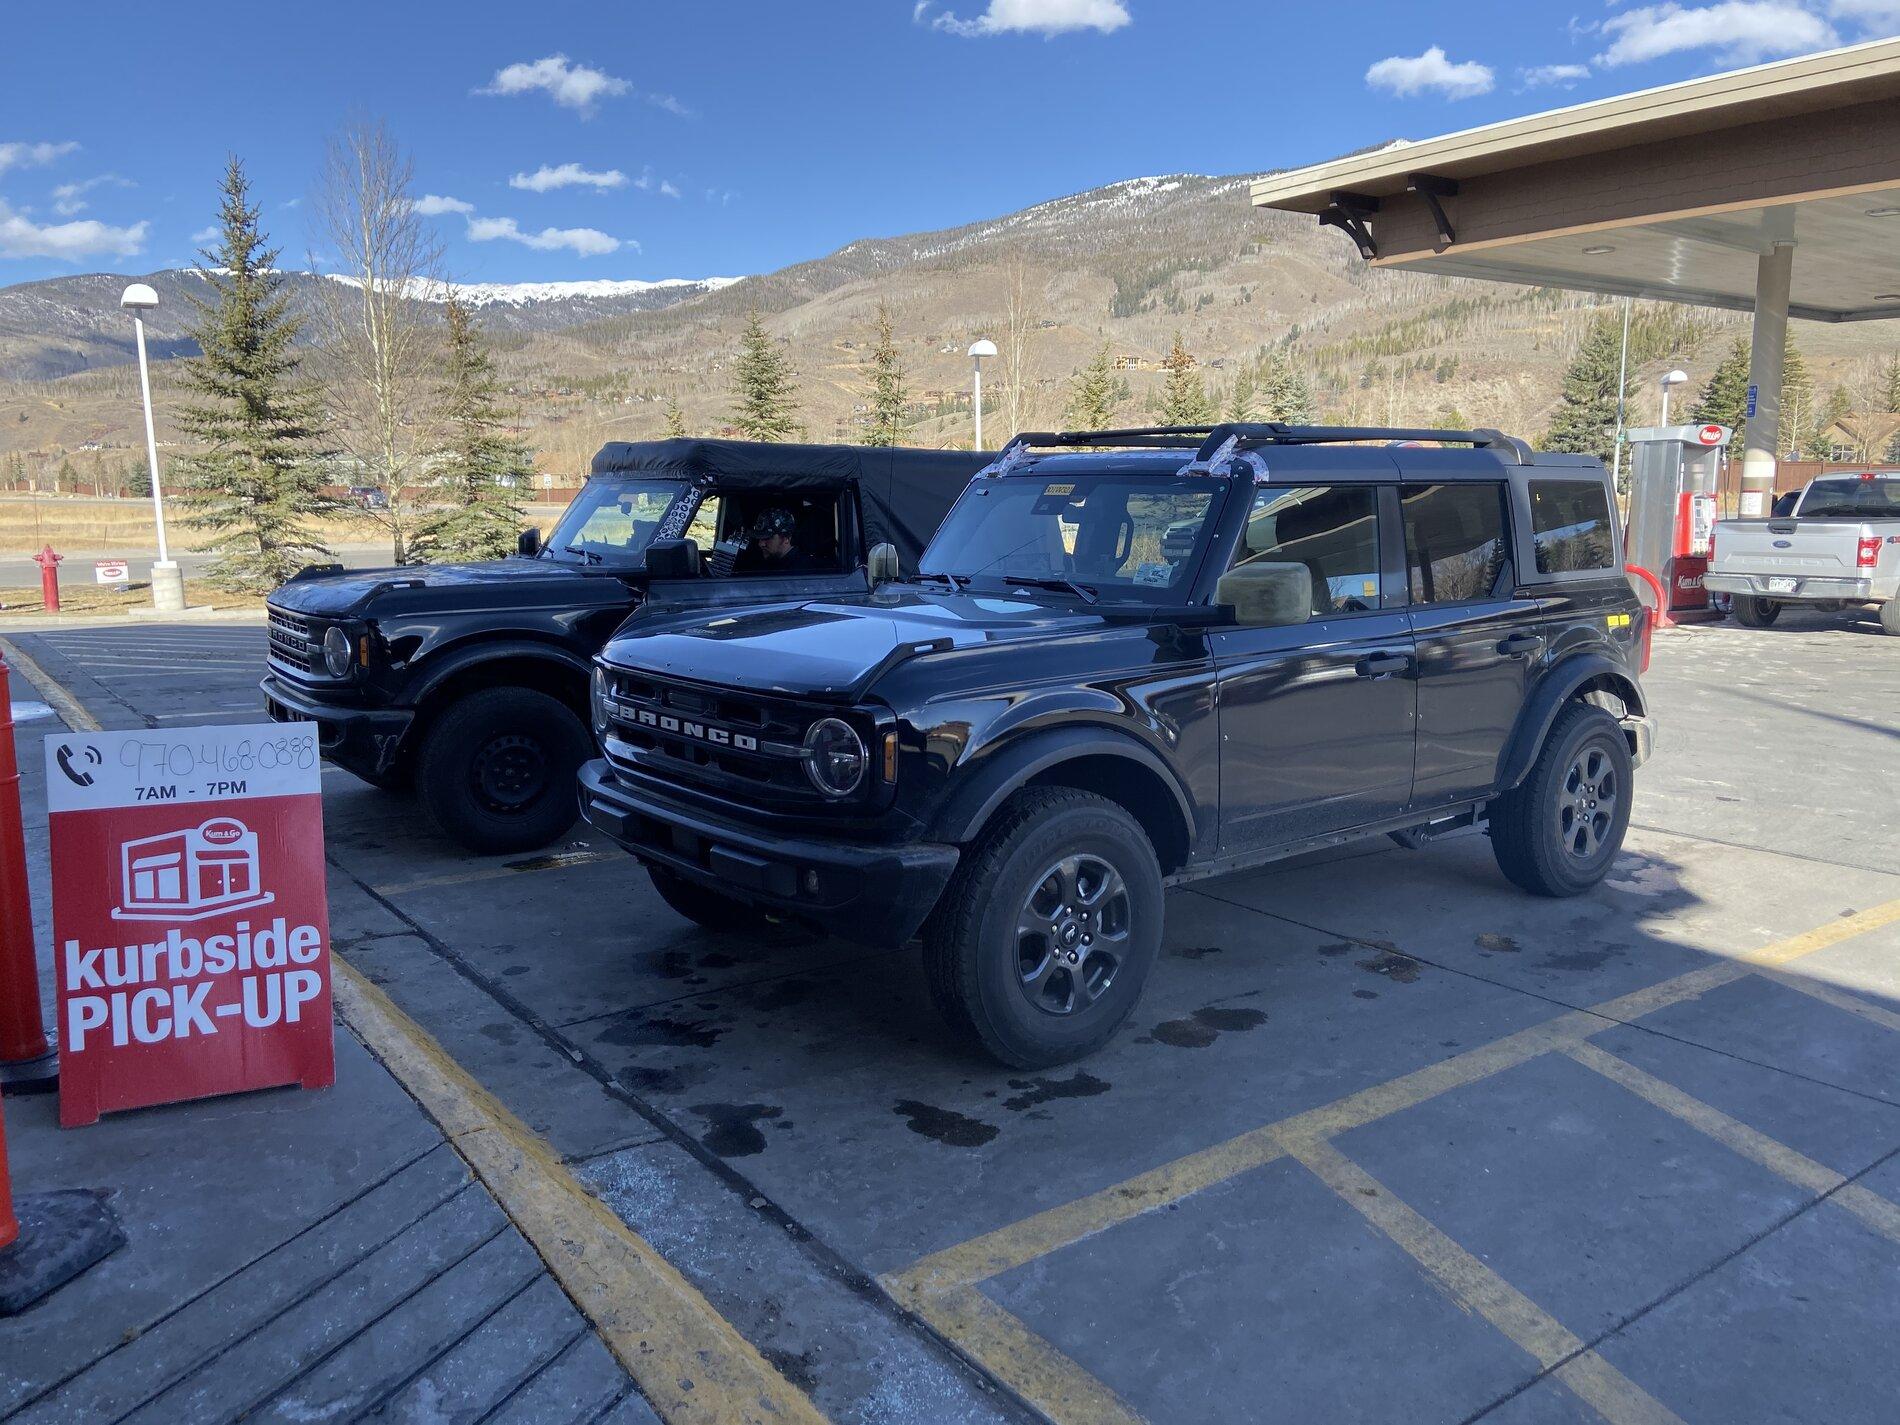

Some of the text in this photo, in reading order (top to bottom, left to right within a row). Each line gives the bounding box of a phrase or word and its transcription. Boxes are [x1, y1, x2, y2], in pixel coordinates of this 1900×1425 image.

[620, 705, 756, 750] BRONCO
[135, 785, 177, 800] 7AM
[206, 780, 247, 796] 7PM
[65, 918, 321, 991] kurbside
[67, 969, 322, 1052] PICK-UP
